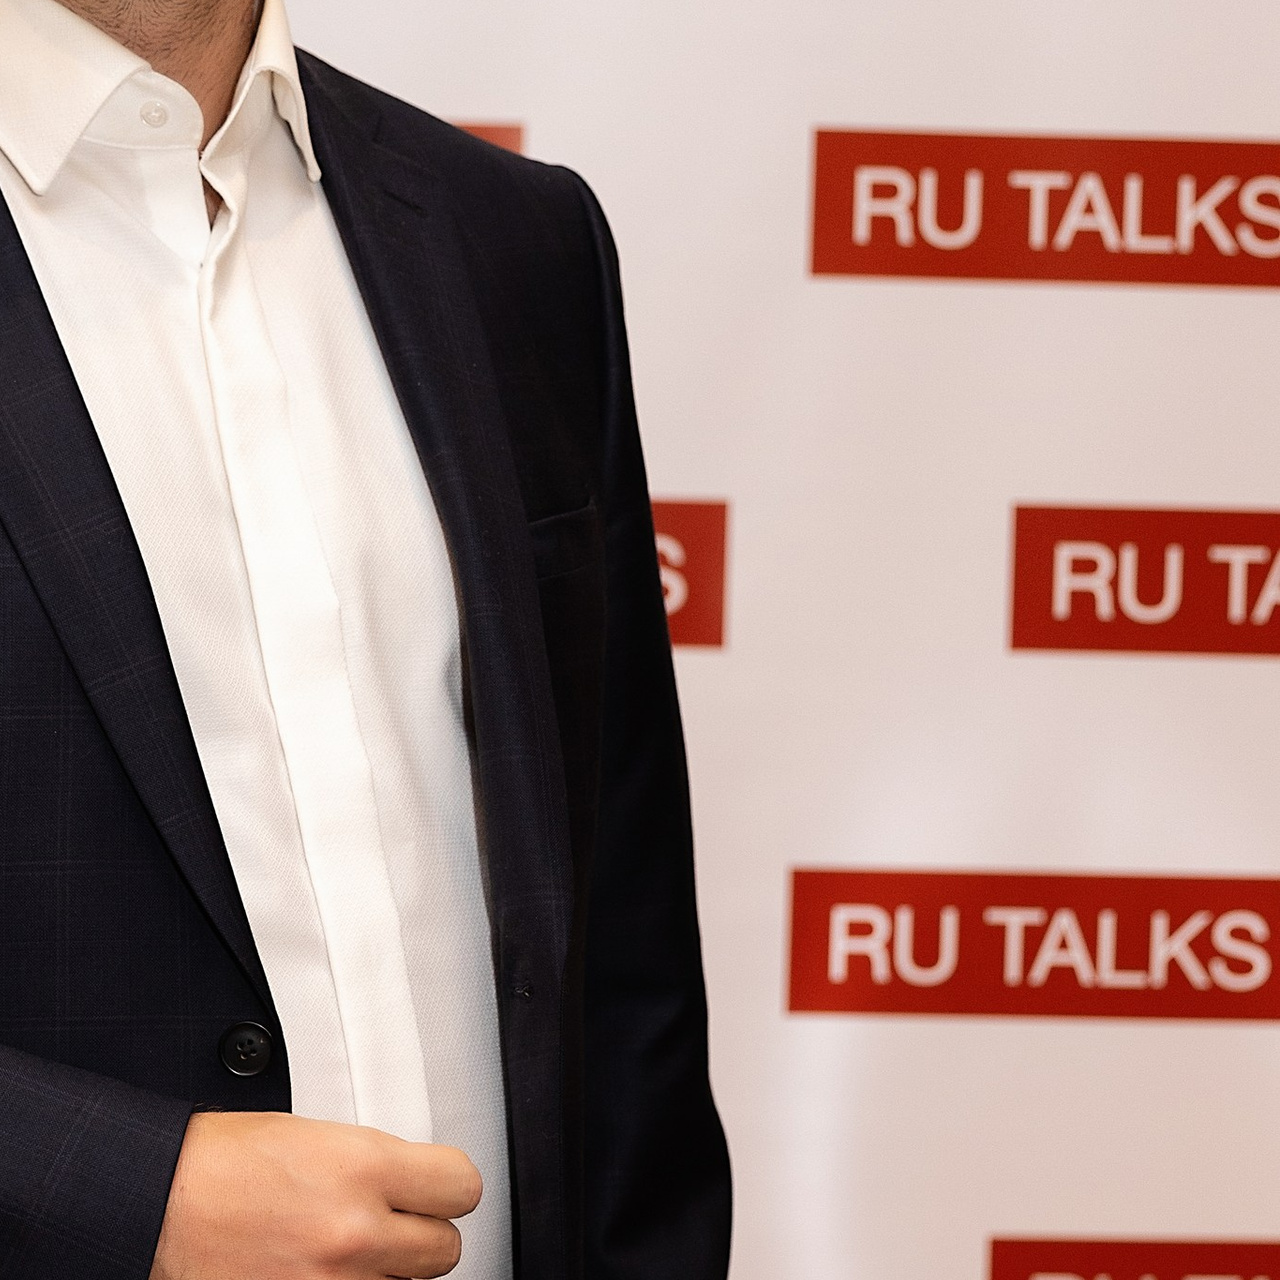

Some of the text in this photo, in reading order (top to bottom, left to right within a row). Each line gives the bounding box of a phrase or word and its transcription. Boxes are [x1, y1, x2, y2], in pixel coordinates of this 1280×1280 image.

[849, 164, 1280, 260] RU TALKS
[1050, 540, 1186, 626] RU
[825, 902, 1274, 994] RU TALKS
